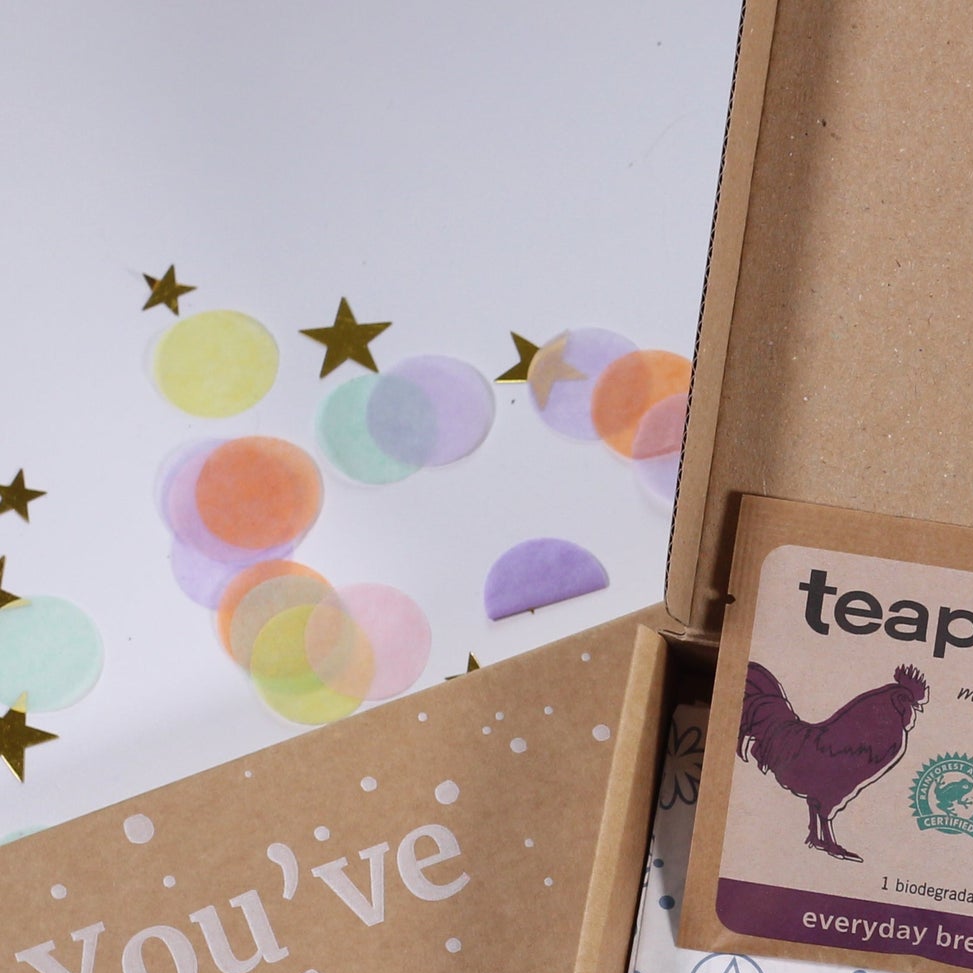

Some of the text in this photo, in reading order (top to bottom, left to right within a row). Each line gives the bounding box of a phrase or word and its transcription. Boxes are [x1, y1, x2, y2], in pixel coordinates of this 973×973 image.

[920, 763, 963, 800] RAINFOREST
[881, 877, 888, 890] 1
[802, 910, 928, 945] everyday
